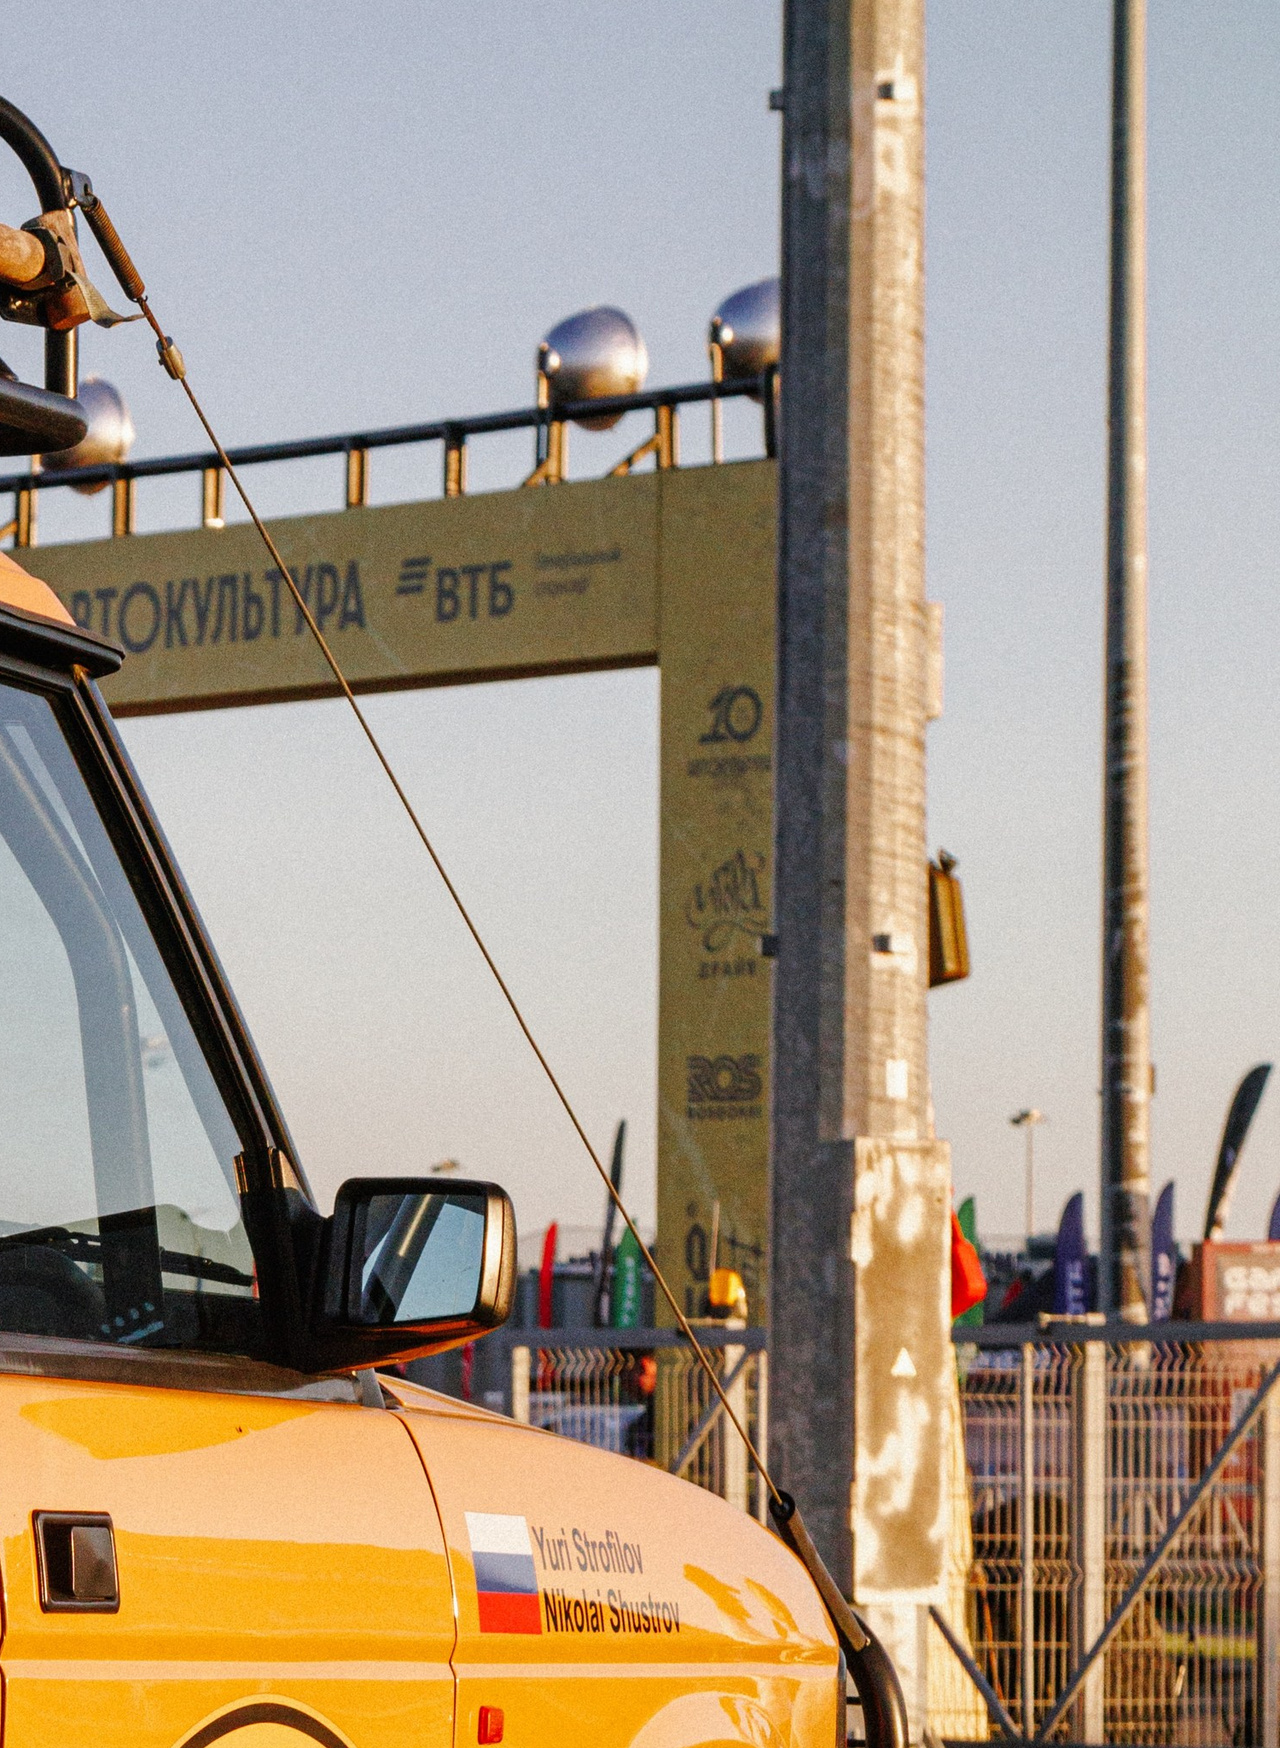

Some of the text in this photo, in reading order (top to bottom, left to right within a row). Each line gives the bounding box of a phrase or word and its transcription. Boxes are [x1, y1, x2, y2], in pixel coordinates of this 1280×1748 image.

[70, 563, 366, 653] ВТОКУЛЬТУРА
[435, 561, 515, 622] ВТБ
[698, 685, 764, 745] 10
[531, 1525, 643, 1575] Yuri Strofilov
[543, 1587, 681, 1634] Nikolai Shustrov
